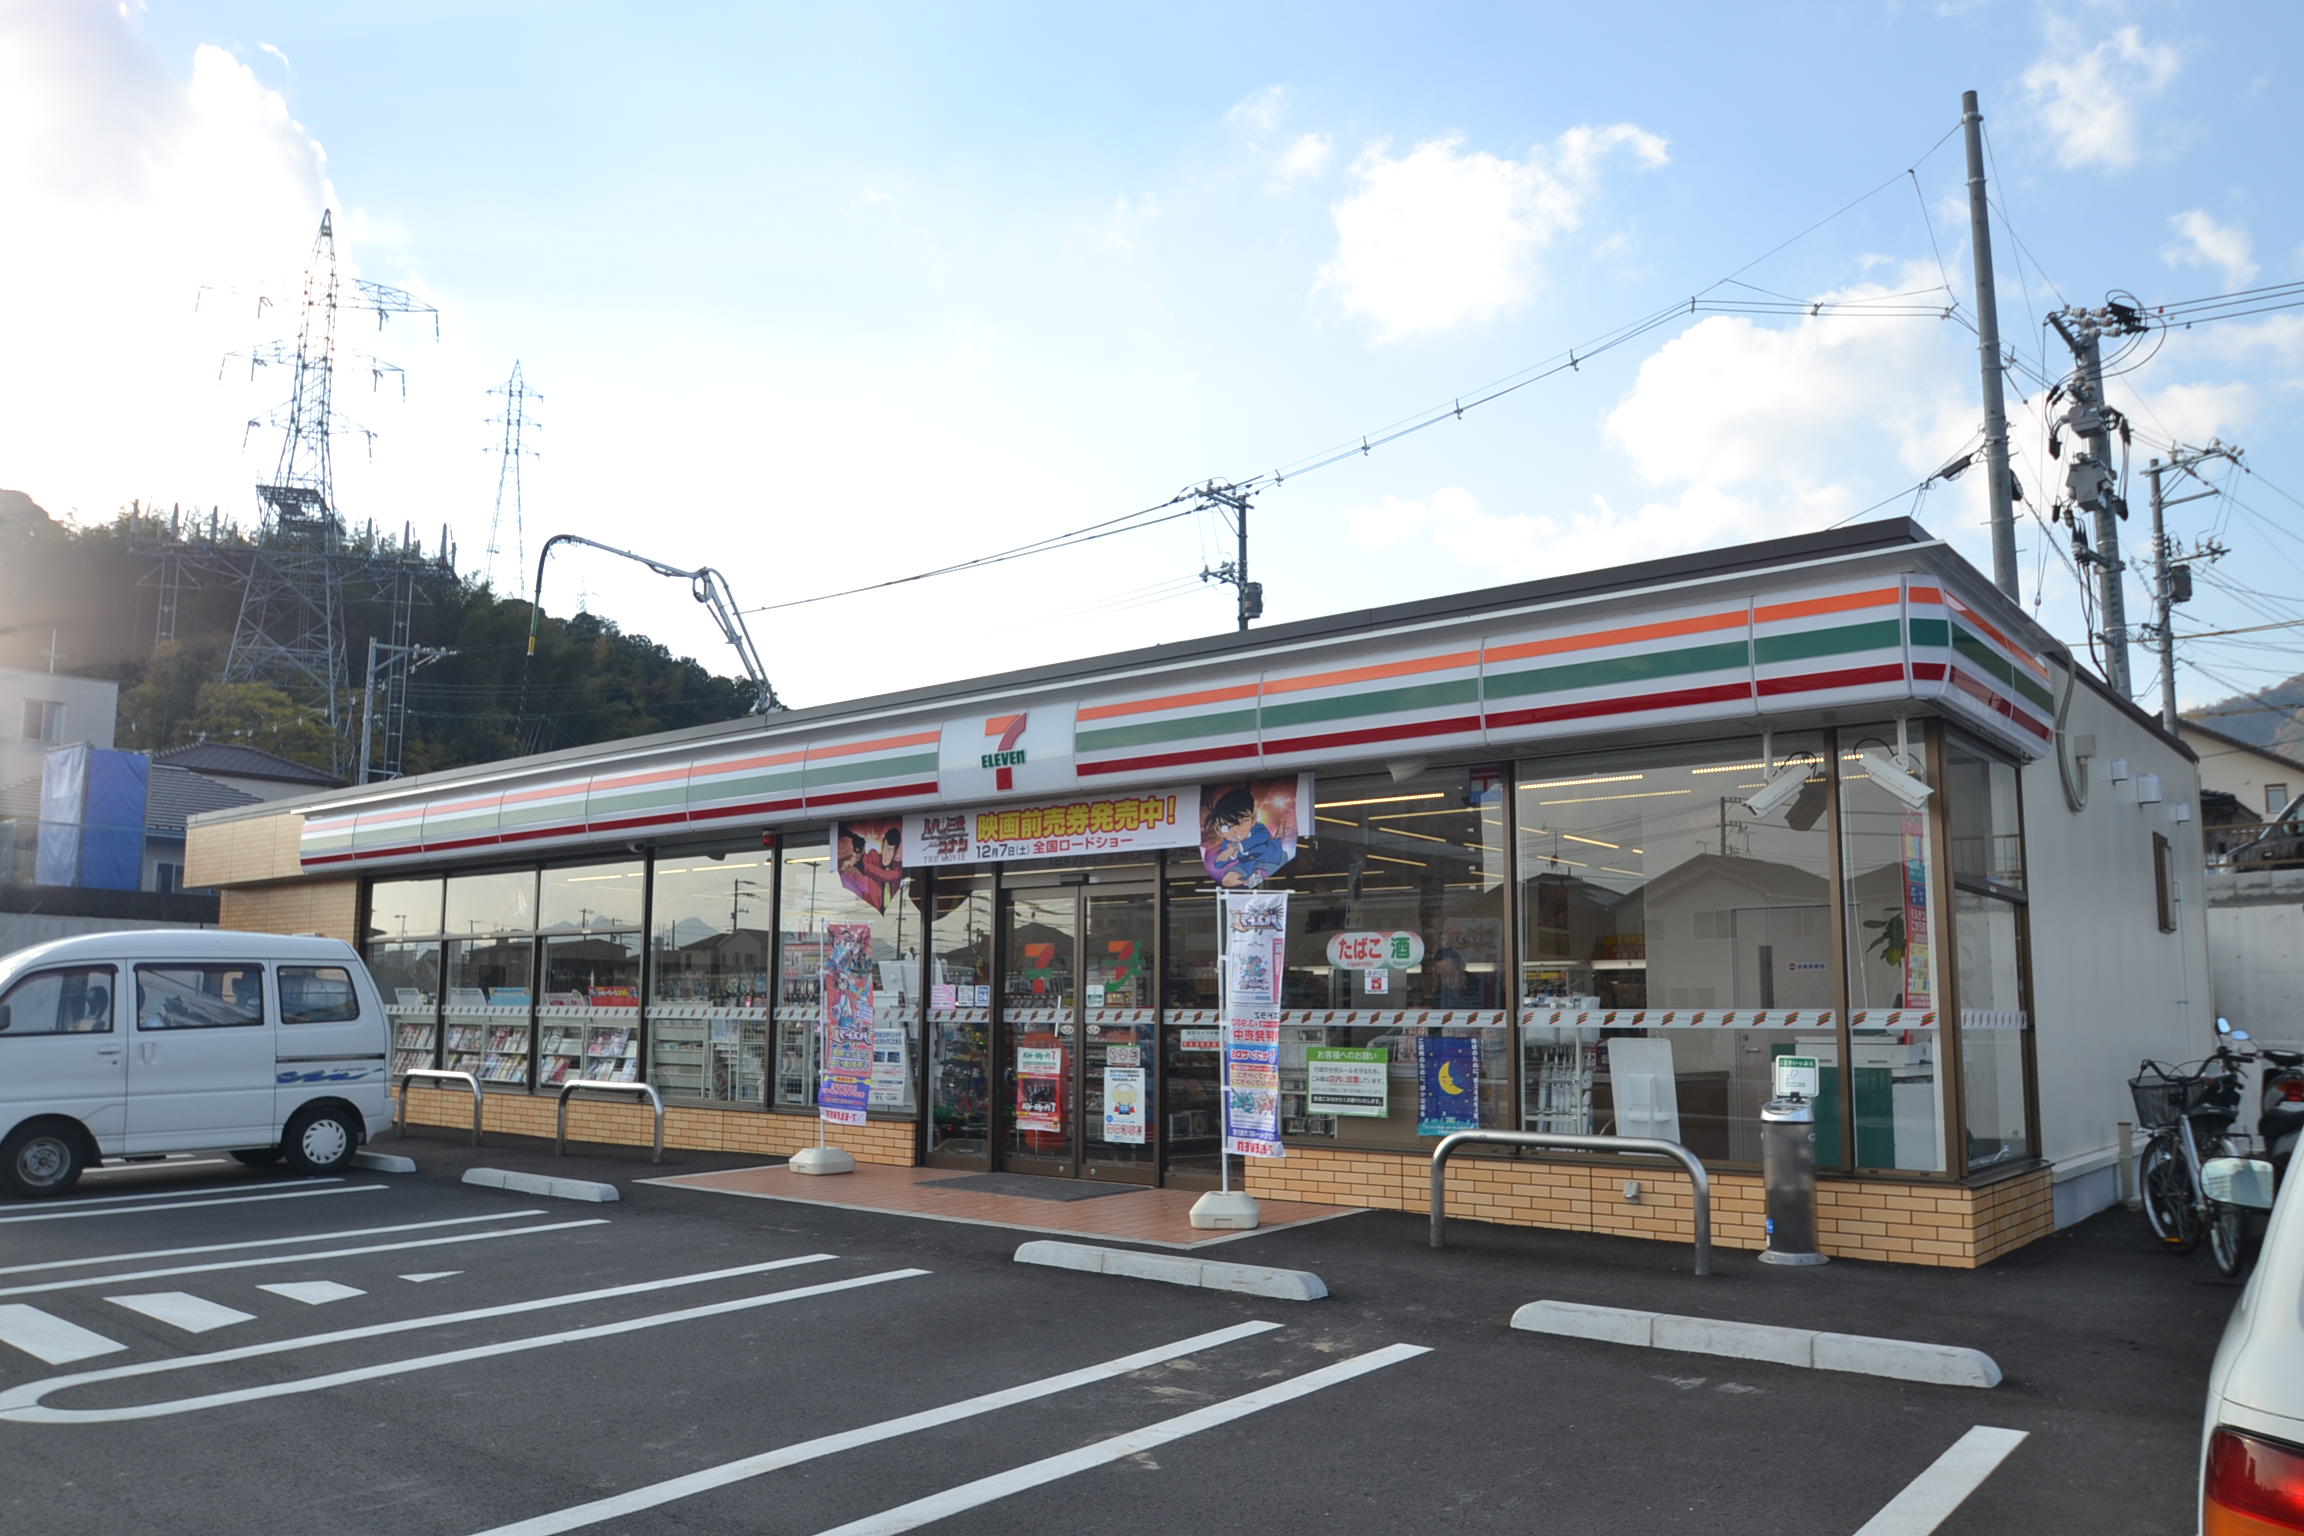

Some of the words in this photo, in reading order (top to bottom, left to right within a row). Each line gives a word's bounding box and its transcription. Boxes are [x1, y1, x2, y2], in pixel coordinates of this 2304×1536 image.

[984, 712, 1028, 791] 7
[1032, 836, 1133, 855] 全国ロードショー
[1338, 936, 1383, 960] たばこ
[1390, 936, 1411, 960] 酒
[1317, 1051, 1378, 1061] お客様へのお願い
